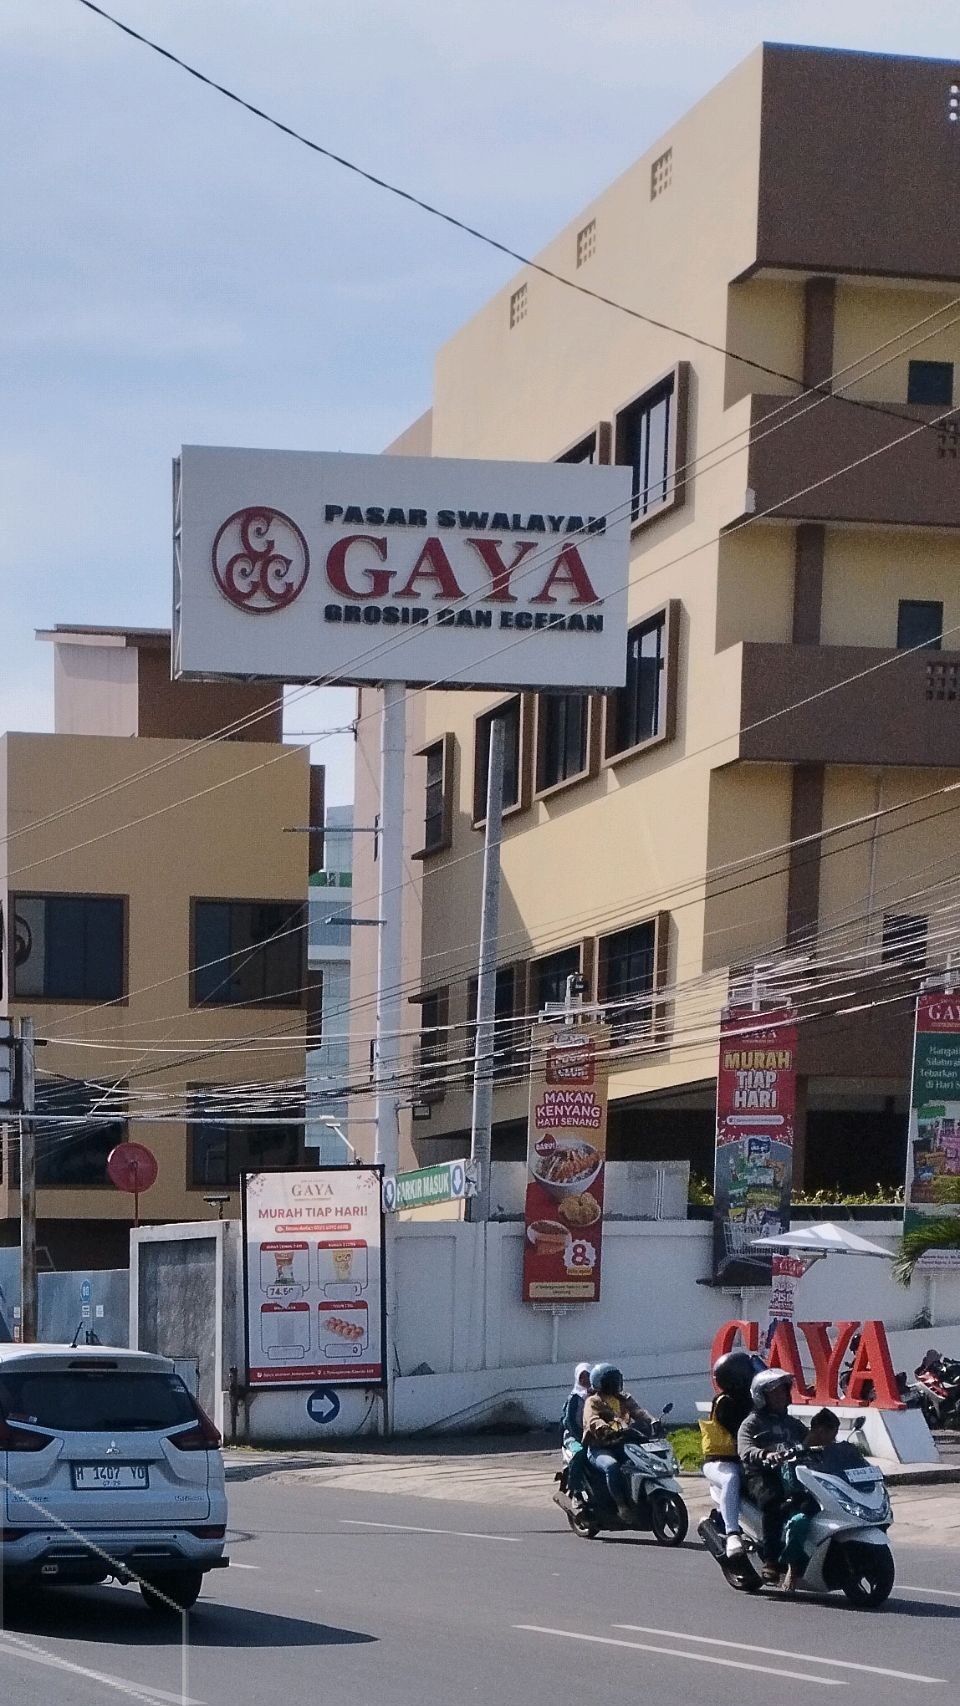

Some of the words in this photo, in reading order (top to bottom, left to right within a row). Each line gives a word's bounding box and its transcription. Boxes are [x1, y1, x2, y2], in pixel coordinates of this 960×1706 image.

[325, 504, 428, 527] PASAR
[437, 509, 607, 535] SWALAYAN
[326, 534, 604, 606] GAYA
[324, 604, 429, 627] GROSIR
[437, 609, 492, 629] DAN
[500, 611, 604, 633] ECERAN
[724, 1051, 790, 1070] MURAH
[736, 1070, 778, 1089] TIAP
[545, 1091, 594, 1104] MAKAN
[734, 1089, 778, 1108] HARI
[537, 1105, 600, 1117] KENYANG
[537, 1118, 558, 1127] HATI
[560, 1117, 599, 1127] SENANG
[291, 1183, 335, 1197] GAYA
[397, 1179, 422, 1203] PARKIR
[423, 1172, 450, 1197] MASUK
[259, 1207, 302, 1218] MURAH
[305, 1207, 331, 1217] TIAP
[335, 1205, 368, 1217] HARI!
[77, 1467, 84, 1480] H
